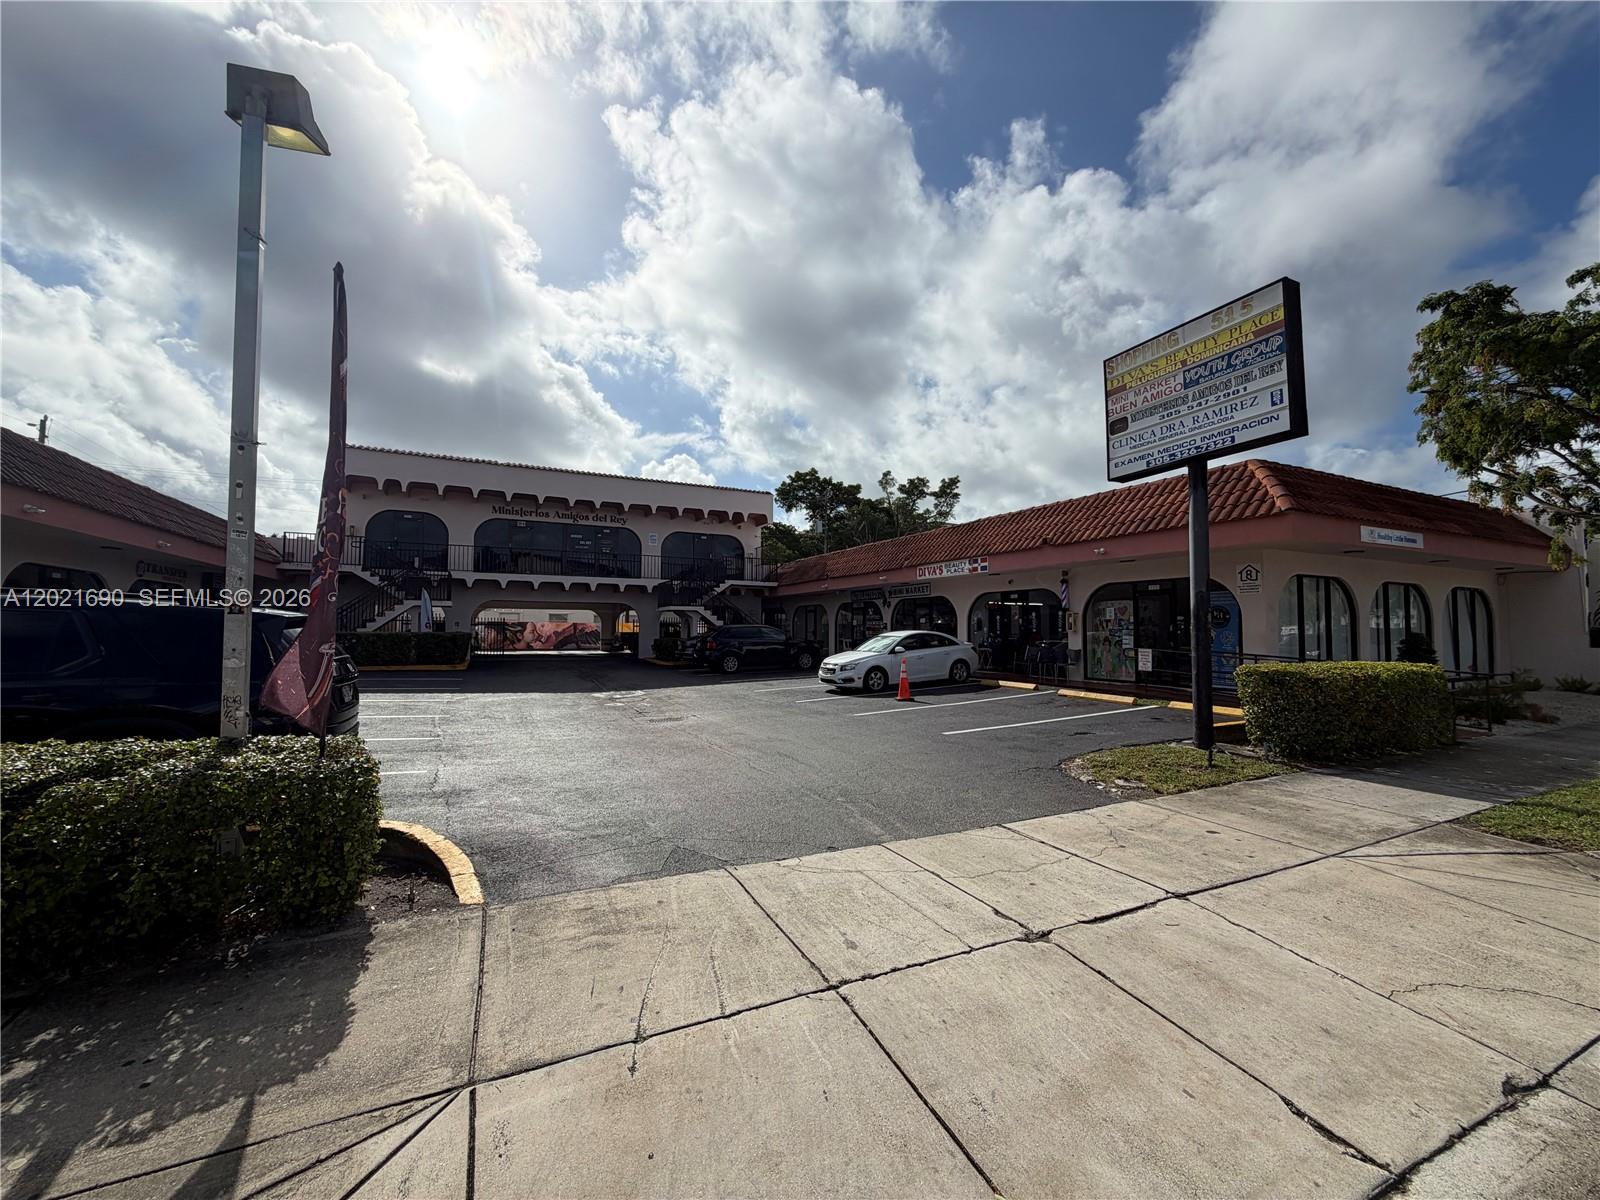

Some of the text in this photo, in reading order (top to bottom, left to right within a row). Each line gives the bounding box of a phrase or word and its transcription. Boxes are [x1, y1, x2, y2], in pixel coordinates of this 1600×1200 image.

[1106, 331, 1180, 376] SHOPPING
[1110, 309, 1281, 389] DIVA'S BEAUTY PLACE
[1126, 333, 1255, 389] PELUQUERIA DOMINICANA
[1184, 335, 1283, 383] YOUTH GROUP
[1110, 375, 1178, 407] MINI MARKET
[1191, 378, 1233, 403] AMIGOS
[1233, 370, 1257, 388] DEL
[1258, 359, 1284, 379] REY
[1199, 367, 1233, 384] SATURDAY
[1107, 382, 1184, 417] BUEN AMIGO
[1112, 429, 1157, 450] CLINICA
[1160, 420, 1189, 436] DRA.
[1192, 395, 1260, 425] RAMIREZ
[1129, 414, 1235, 450] MEDICINA GENERAL GINECOLOGIA
[1114, 413, 1280, 469] EXAMEN MEDICO INMIGRACION
[491, 505, 629, 526] Ministerios Amigos del Rey
[918, 564, 944, 578] DIVA'S
[944, 560, 968, 569] BEAUTY
[946, 566, 965, 574] PLACE
[905, 585, 929, 594] MARKET
